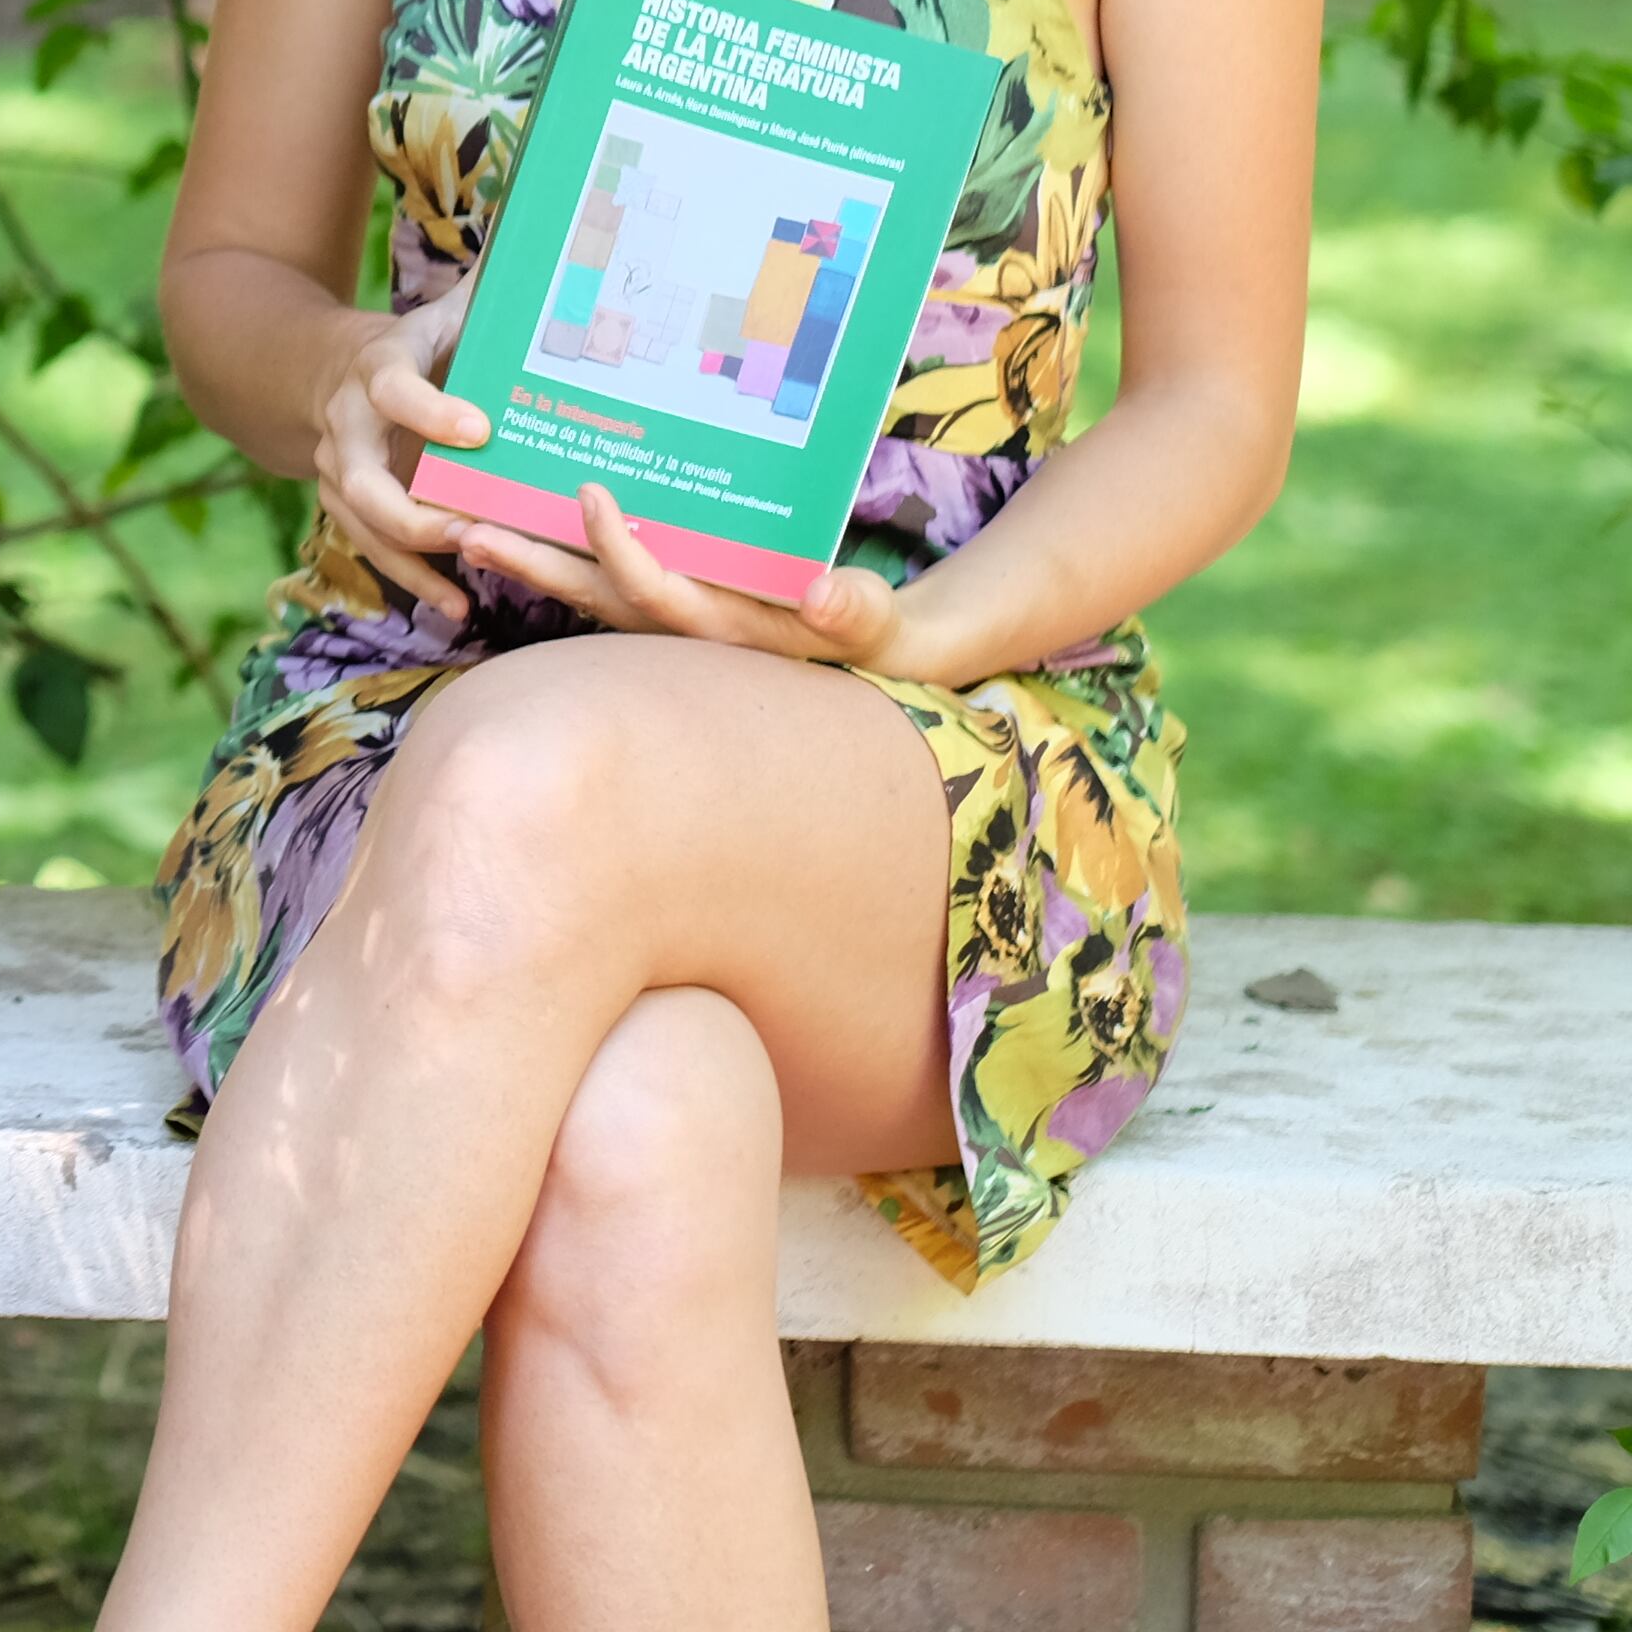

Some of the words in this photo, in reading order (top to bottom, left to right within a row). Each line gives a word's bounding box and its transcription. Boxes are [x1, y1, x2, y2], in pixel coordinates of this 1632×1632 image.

[622, 42, 768, 110] ARGENTINA
[633, 14, 671, 48] DE
[673, 28, 706, 62] LA
[712, 41, 865, 109] LITERATURA
[765, 28, 901, 90] FEMINISTA
[761, 123, 769, 134] y
[559, 426, 577, 443] de
[578, 430, 591, 447] la
[654, 454, 665, 470] y
[665, 455, 679, 471] la
